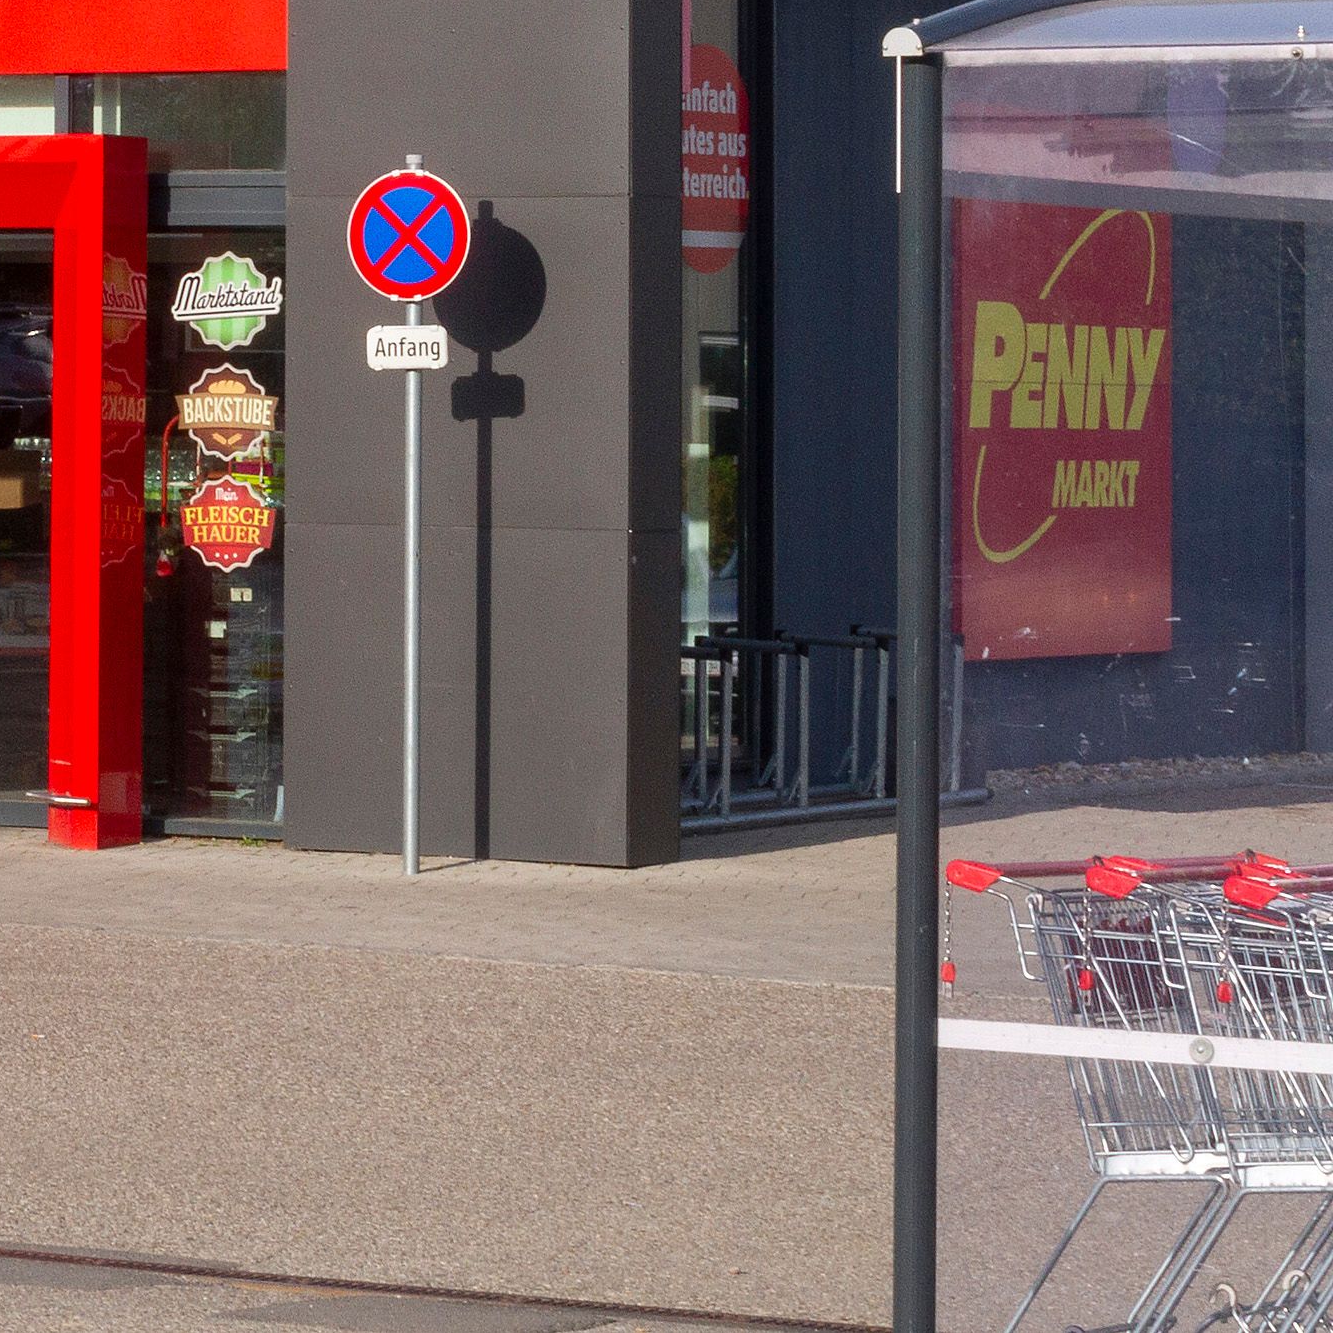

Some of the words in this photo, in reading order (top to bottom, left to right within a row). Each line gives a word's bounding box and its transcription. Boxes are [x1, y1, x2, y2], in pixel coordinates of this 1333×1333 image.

[717, 132, 747, 158] aus
[174, 275, 279, 313] Marktstand
[374, 331, 440, 362] Anfang
[969, 300, 1166, 430] PENNY
[182, 396, 274, 426] BACKSTUBE
[1051, 460, 1140, 508] MARKT
[184, 506, 271, 527] FLEISCH
[192, 525, 262, 545] HAUER
